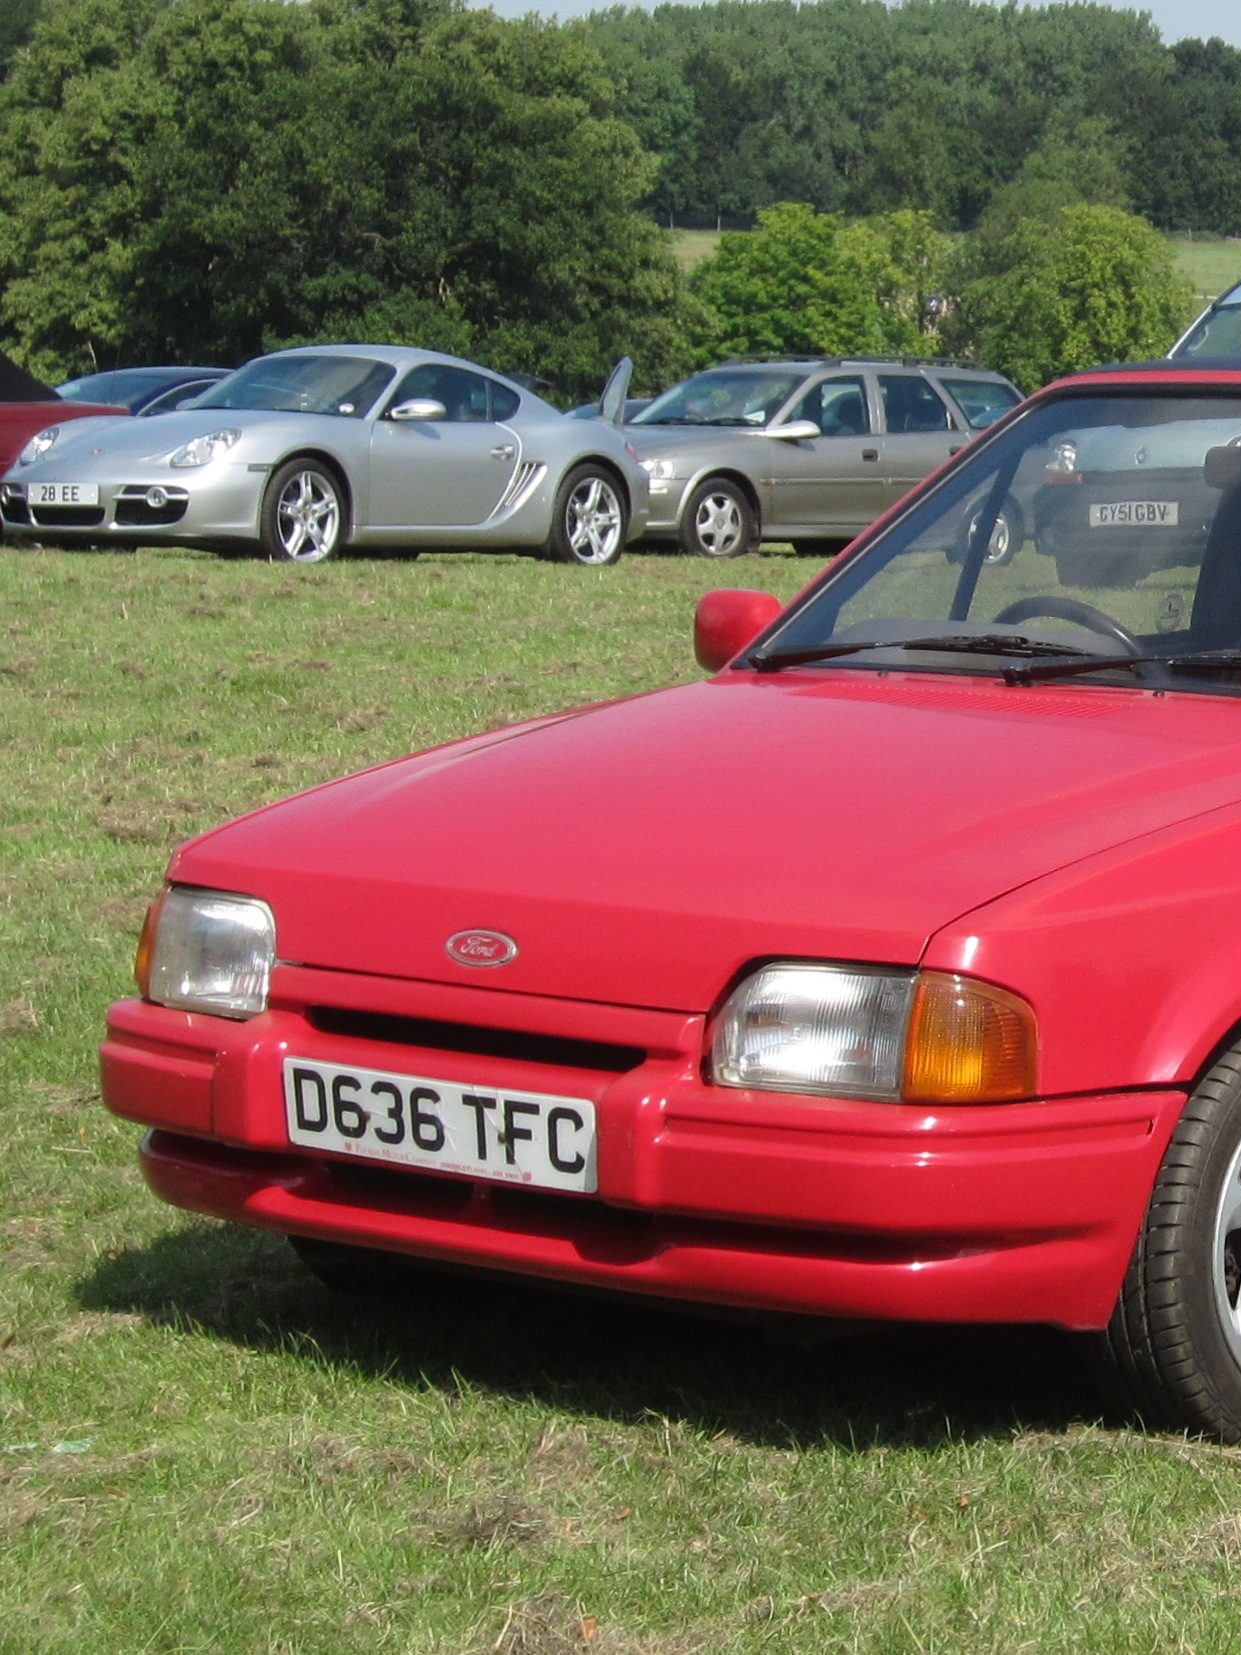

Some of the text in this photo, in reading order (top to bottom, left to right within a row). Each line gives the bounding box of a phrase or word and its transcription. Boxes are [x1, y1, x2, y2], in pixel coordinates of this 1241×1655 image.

[41, 485, 79, 502] 28 EE
[460, 935, 499, 957] Ford
[292, 1067, 586, 1174] D636 TFC
